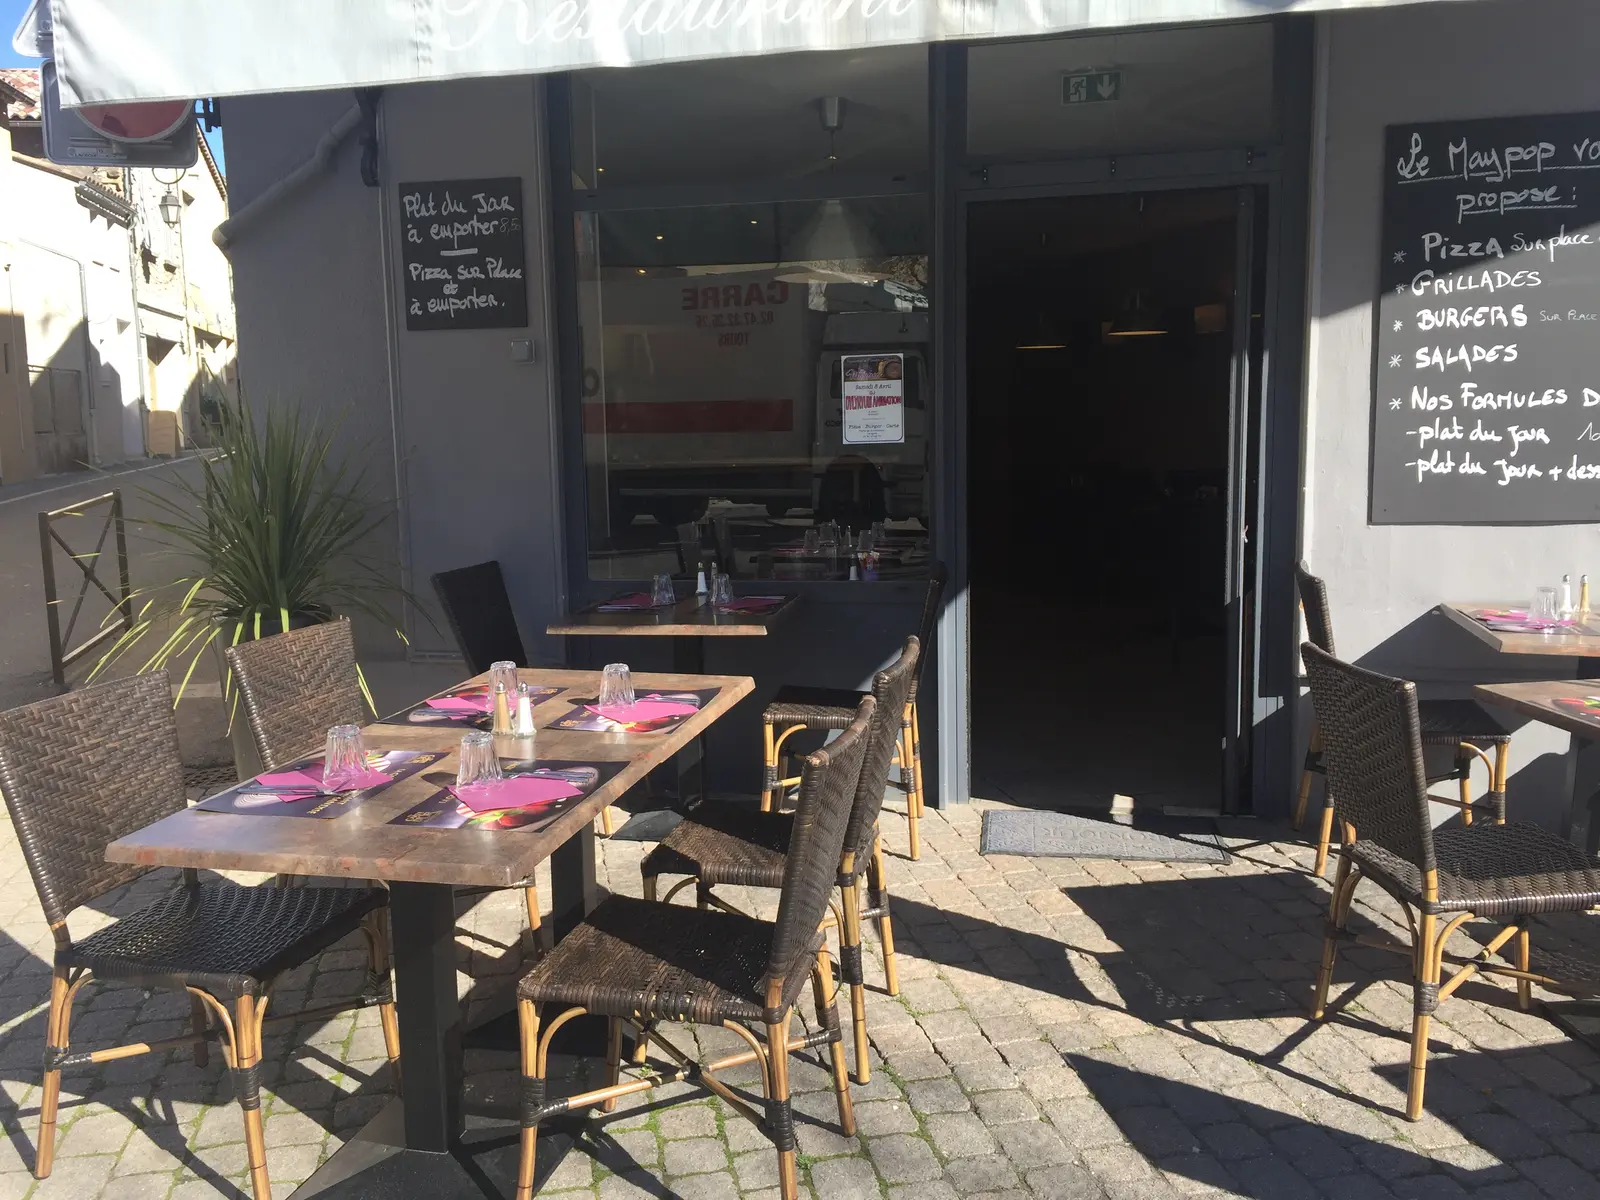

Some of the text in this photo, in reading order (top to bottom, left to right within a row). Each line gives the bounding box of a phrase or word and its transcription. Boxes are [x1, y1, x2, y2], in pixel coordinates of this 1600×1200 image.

[1397, 132, 1430, 179] Le
[1448, 137, 1556, 182] Maypop
[402, 192, 437, 218] Plat
[441, 191, 468, 216] du
[407, 223, 423, 243] à
[430, 214, 499, 249] emporter
[1548, 224, 1594, 262] place
[409, 262, 452, 281] Pizza
[485, 257, 522, 279] Place
[443, 280, 459, 295] et
[1411, 270, 1542, 296] GRILLADES
[410, 298, 423, 315] à
[1416, 304, 1528, 331] BURGERS
[1567, 308, 1598, 321] PLACE
[1415, 344, 1519, 372] SALADES
[1469, 419, 1503, 441] du
[1457, 452, 1487, 475] du
